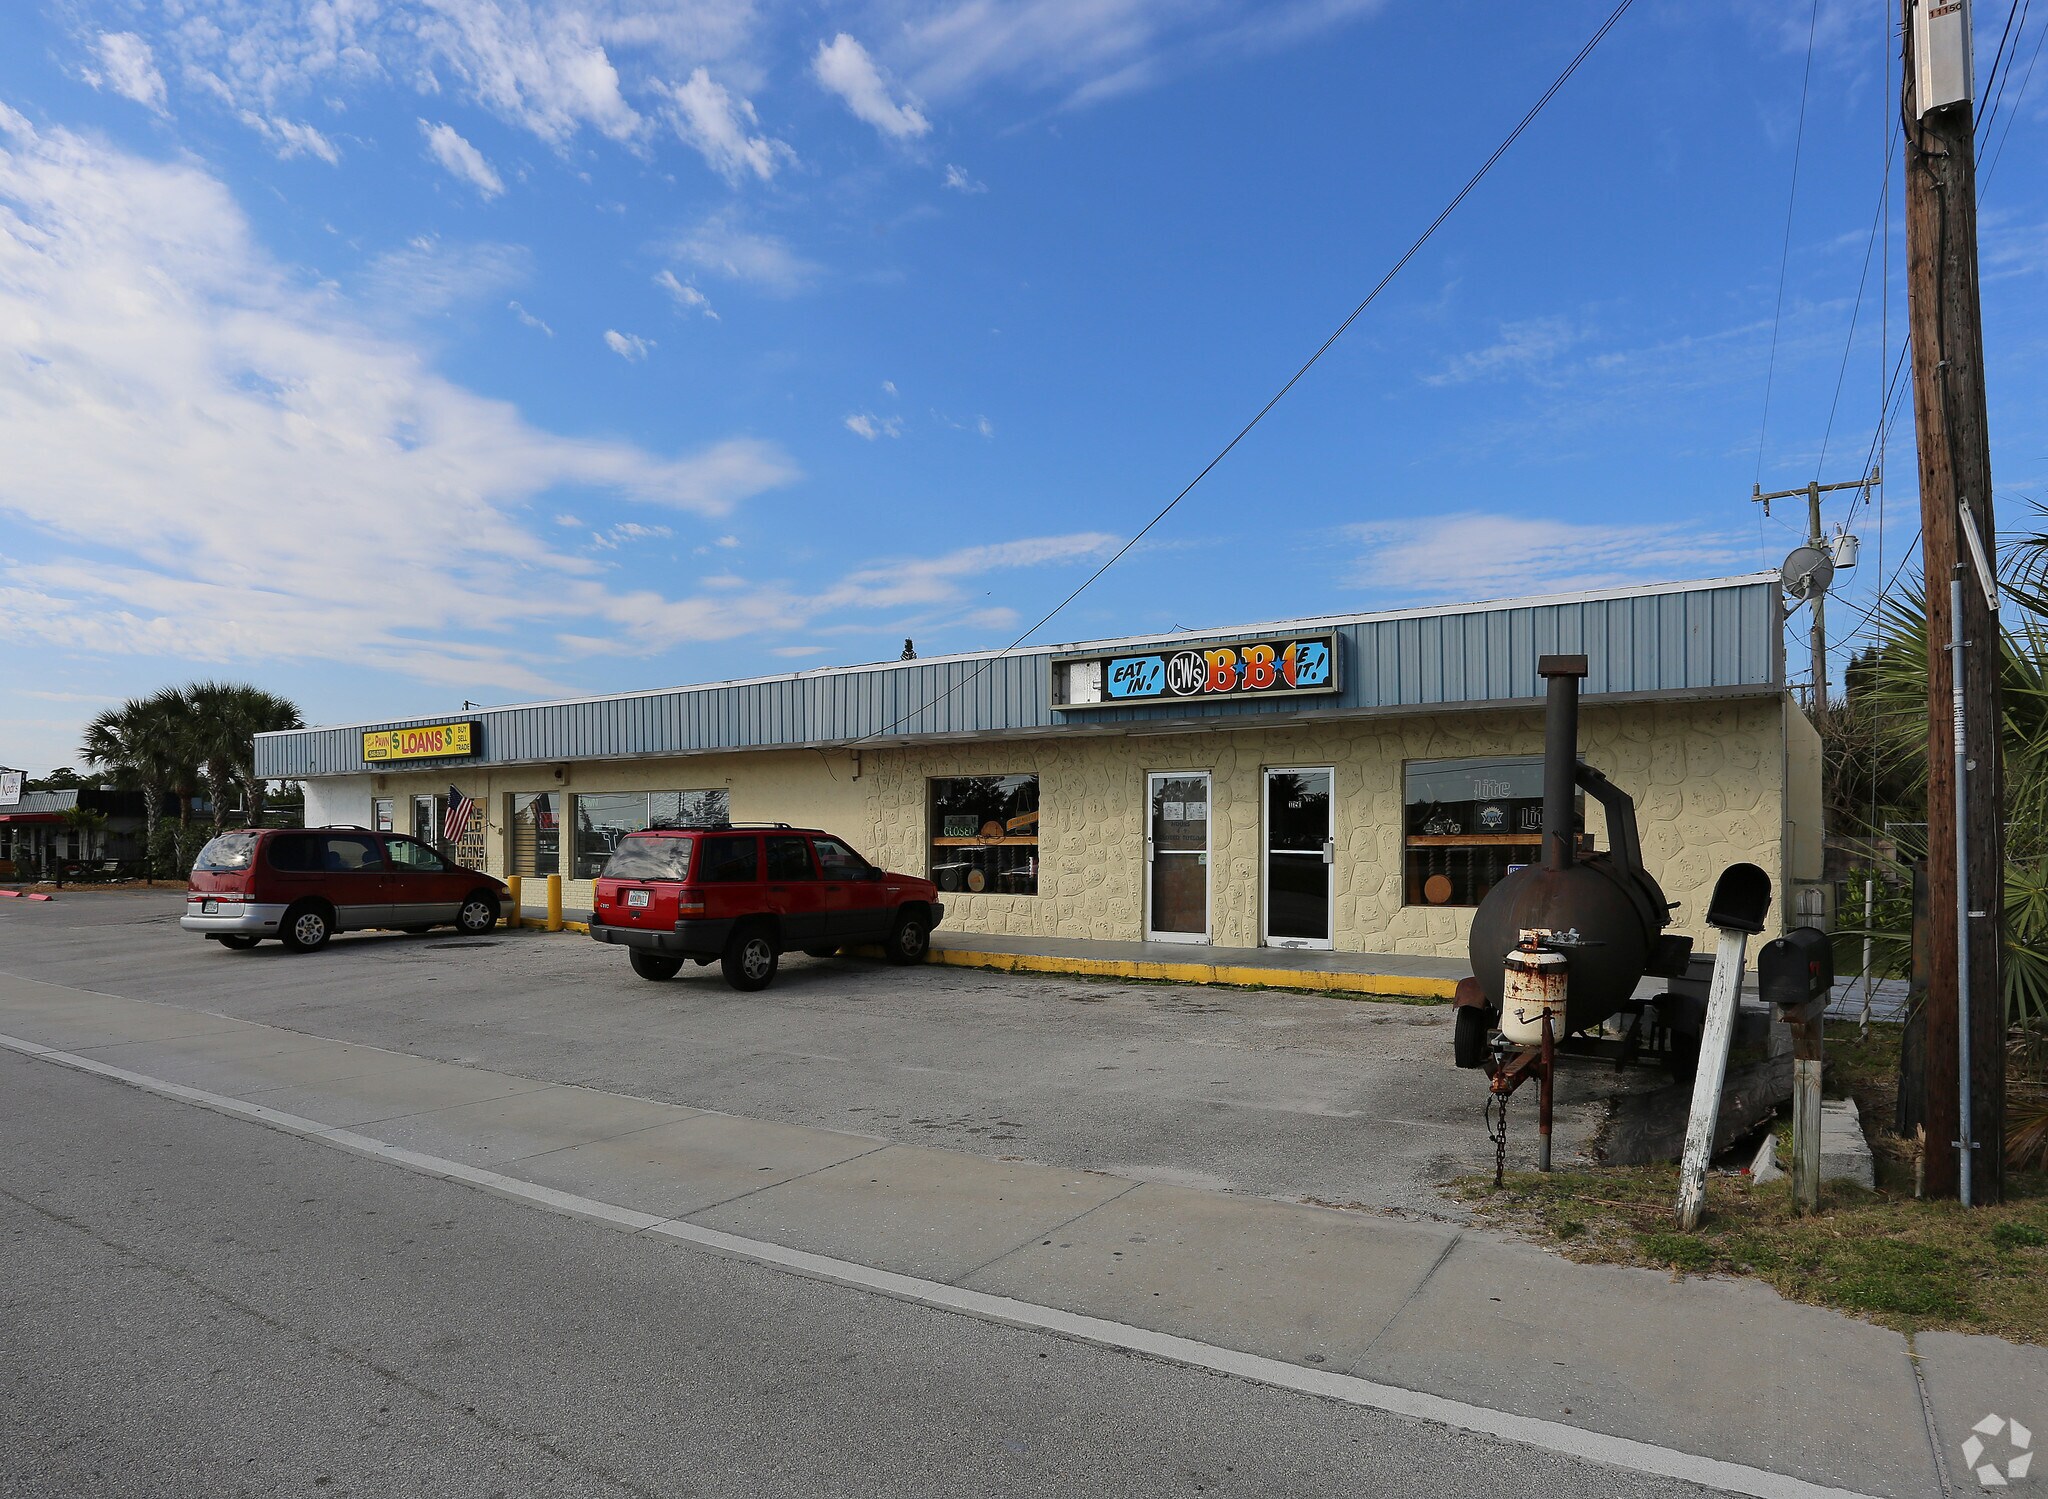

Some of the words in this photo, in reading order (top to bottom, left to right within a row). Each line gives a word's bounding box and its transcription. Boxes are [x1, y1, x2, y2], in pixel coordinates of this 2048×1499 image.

[1930, 3, 1963, 18] 11150
[1114, 661, 1146, 682] EAT
[1127, 665, 1160, 694] IN!
[457, 726, 467, 734] BUY
[375, 735, 390, 748] PAWN
[401, 730, 444, 755] LOANS
[1473, 779, 1512, 802] Lite
[943, 826, 976, 838] CLOSED
[461, 834, 484, 846] AWN
[457, 847, 485, 858] LOANS
